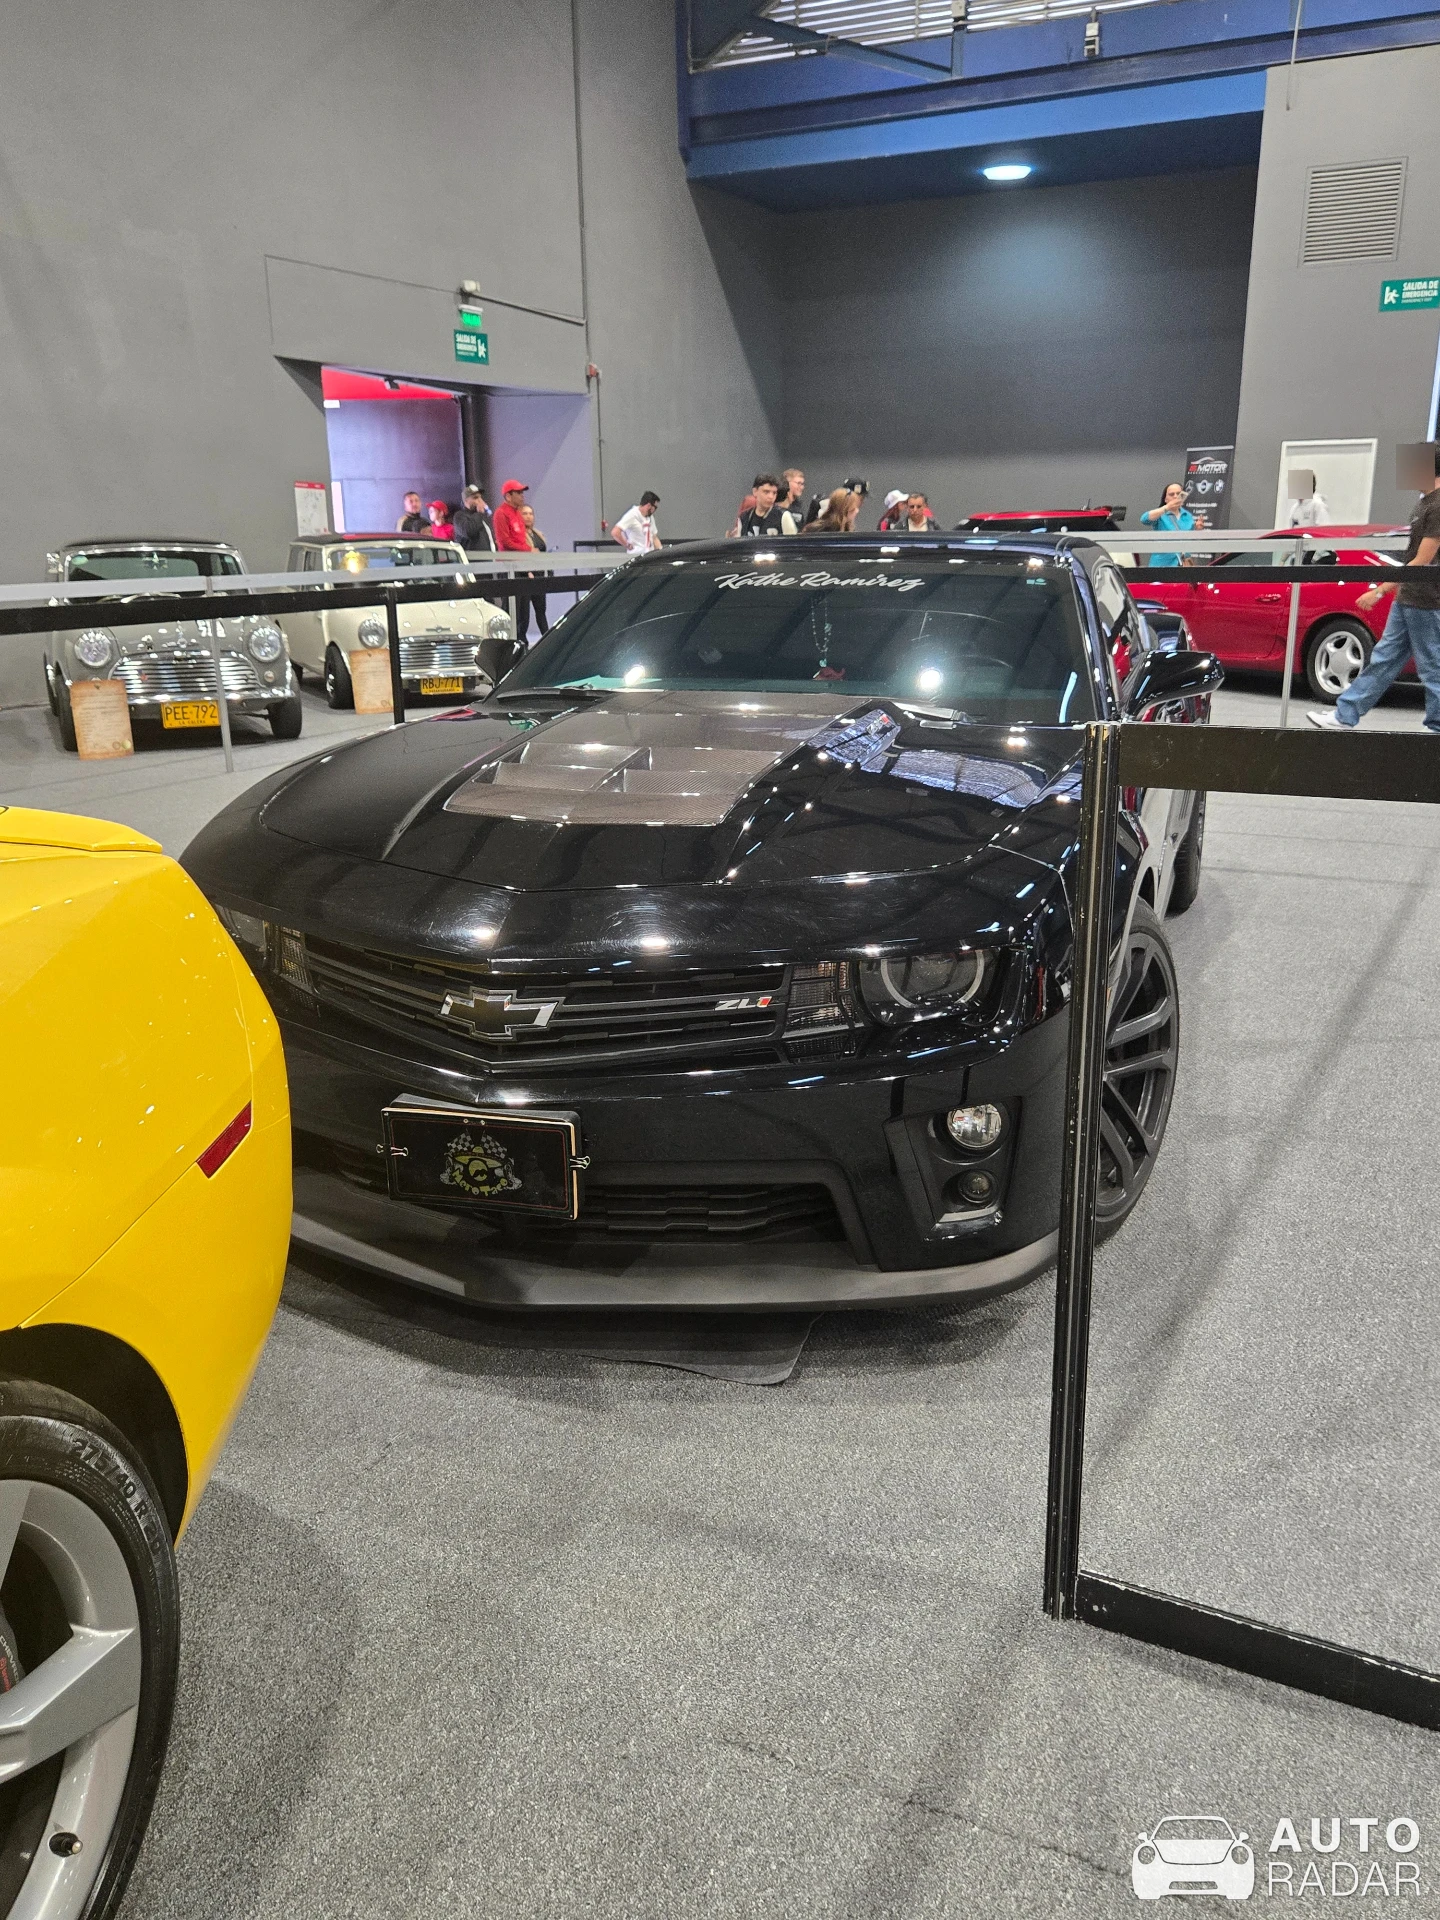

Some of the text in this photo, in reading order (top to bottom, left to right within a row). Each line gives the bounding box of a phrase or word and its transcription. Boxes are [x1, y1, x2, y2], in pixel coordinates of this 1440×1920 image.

[1403, 280, 1439, 290] SALIDA DE
[714, 571, 925, 592] Kathe Ramirez
[714, 996, 772, 1011] ZL1
